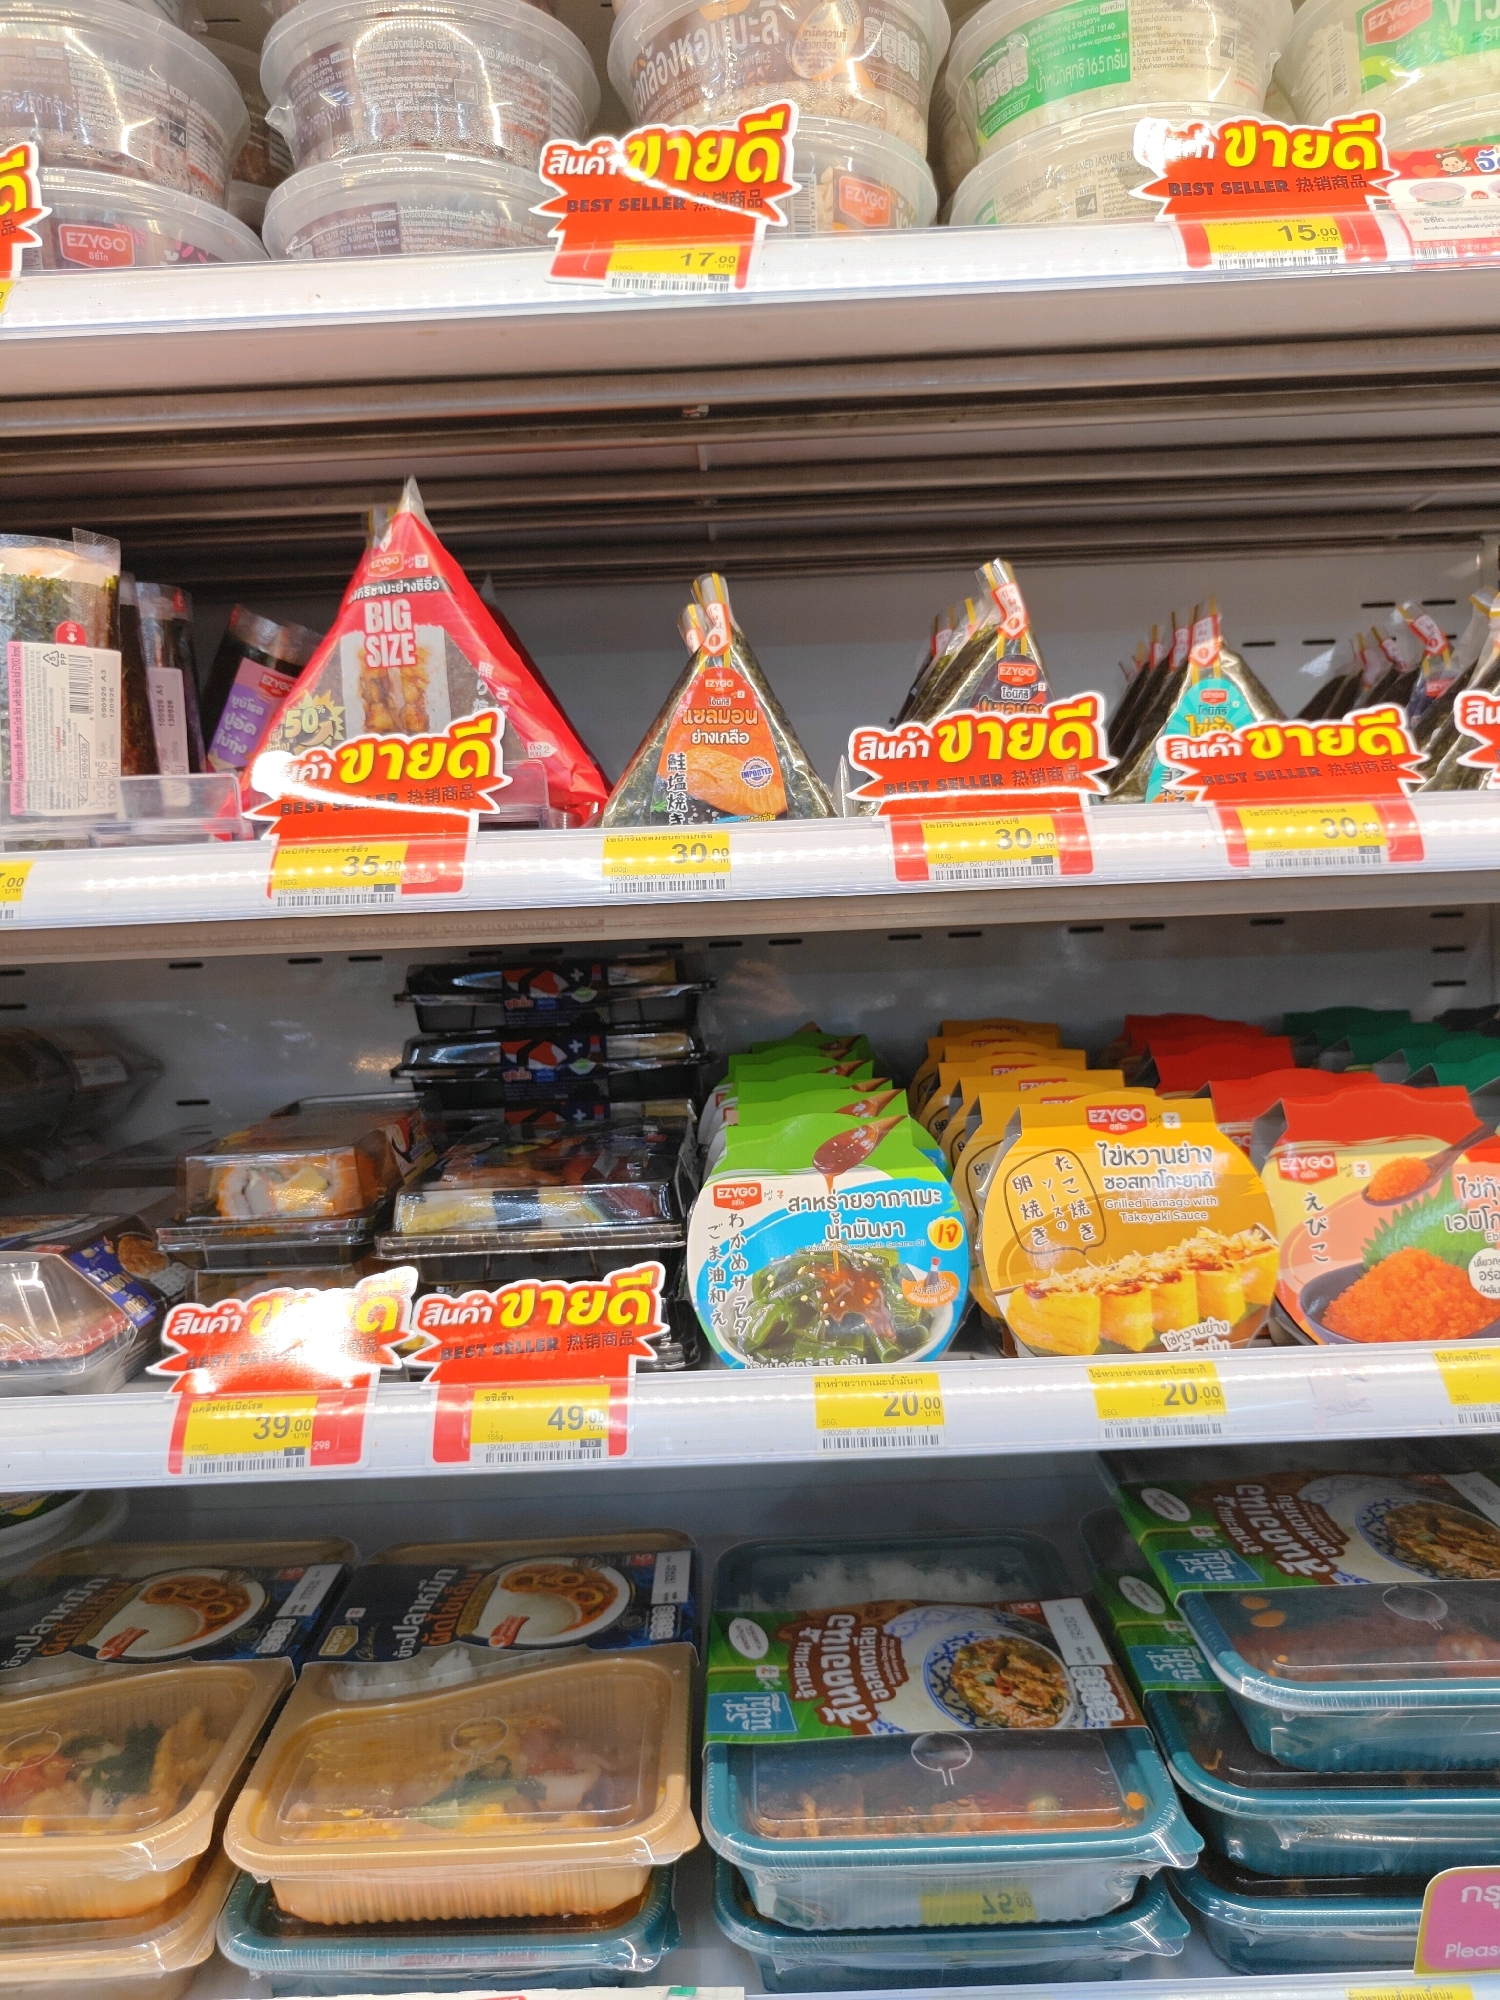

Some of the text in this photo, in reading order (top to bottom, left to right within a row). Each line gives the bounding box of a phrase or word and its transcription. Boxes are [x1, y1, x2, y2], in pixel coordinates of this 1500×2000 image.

[1097, 22, 1116, 32] 12140
[1106, 47, 1128, 71] กรัม
[1228, 42, 1234, 56] 4
[756, 56, 772, 66] RICE
[467, 86, 476, 100] 4
[178, 132, 185, 145] 4
[626, 110, 786, 184] ขายดี
[1224, 118, 1378, 170] ขายดี
[1095, 151, 1125, 167] JASMINE
[845, 182, 887, 209] EZYGO
[1168, 173, 1368, 197] BEST SELLER 热销商品
[567, 188, 763, 213] BEST SELLER 热销商品
[1086, 197, 1096, 212] 4
[66, 231, 127, 252] EZYGO
[376, 229, 397, 238] 12140
[1277, 224, 1338, 243] 15.00
[680, 252, 737, 268] 17.00
[371, 555, 400, 569] EZYGO
[365, 599, 412, 633] BIG
[60, 653, 67, 666] PP
[365, 632, 416, 668] SIZE
[101, 669, 107, 682] A3
[999, 665, 1035, 678] EZYGO
[705, 679, 734, 688] EZYGO
[1001, 686, 1029, 700] โอนิกิริ
[156, 685, 166, 727] 100926 A5
[167, 700, 175, 727] 130926
[682, 708, 759, 725] แซลมอน
[691, 728, 750, 745] ย่างเกลือ
[858, 732, 930, 761] สินค้า
[937, 700, 1094, 764] ขายดี
[1170, 735, 1242, 759] สินค้า
[1247, 711, 1404, 759] ขายดี
[339, 717, 493, 784] ขายดี
[740, 768, 773, 779] IMPORTED
[883, 764, 1083, 796] BEST SELLER 热销商品
[1201, 759, 1399, 786] BEST SELLER 热销商品
[280, 784, 476, 816] BEST 热销商品
[667, 753, 688, 826] 鮭塩焼き
[995, 828, 1055, 850] 30.00
[1320, 817, 1380, 839] 30.00
[672, 843, 730, 864] 30.00
[935, 861, 964, 869] 1900192
[987, 859, 1012, 867] 02/8/11
[342, 855, 402, 878] 35.00
[312, 887, 325, 895] 620
[362, 885, 370, 893] 1F
[1088, 1107, 1145, 1123] EZYGO
[1097, 1141, 1214, 1167] ไข่หวานย่าง
[1279, 1154, 1335, 1171] EZYGO
[1103, 1168, 1214, 1190] ซอสทาโกะยากิ
[716, 1186, 758, 1199] EZYGO
[787, 1189, 942, 1213] สาหร่ายวากาเมะ
[1054, 1155, 1095, 1242] たこ焼き
[1012, 1174, 1049, 1246] 卵焼き
[1042, 1177, 1068, 1232] ソースの
[1105, 1196, 1217, 1212] Grilled Tamago with
[826, 1212, 904, 1240] น้ำมันงา
[1120, 1210, 1208, 1224] Takoyaki Sauce
[1304, 1191, 1330, 1263] えびこ
[937, 1222, 959, 1244] เจ
[837, 1242, 868, 1250] Seaweed
[869, 1241, 884, 1249] with
[708, 1222, 728, 1327] ごま油和え
[728, 1212, 752, 1335] わかめサラダ
[422, 1299, 493, 1327] สินค้า
[500, 1271, 654, 1328] ขายดี
[172, 1308, 243, 1336] สินค้า
[1163, 1320, 1229, 1348] ไข่หวานย่าง
[440, 1330, 635, 1361] BEST SELLER 热销商品
[186, 1353, 232, 1370] BEST
[1090, 1364, 1207, 1378] ไข่หวานย่างซอสทาโกะยากิ
[815, 1374, 924, 1389] สาหร่ายวากาเมะน้ำมันงา
[883, 1390, 941, 1417] 20.00
[1160, 1381, 1220, 1406] 20.00
[253, 1415, 312, 1440] 39.00
[547, 1405, 606, 1431] 49.00
[588, 1423, 605, 1431] บาท
[822, 1418, 839, 1426] 55G.
[1138, 1417, 1151, 1425] 620
[1157, 1416, 1178, 1424] 03/6/9
[585, 1439, 596, 1447] TD
[823, 1429, 852, 1437] 1900586
[875, 1427, 897, 1435] 03/5/9
[224, 1452, 237, 1460] 620
[392, 1567, 460, 1659] ข้าวปลาหมึก
[793, 1641, 816, 1699] ข้าวพะแนง
